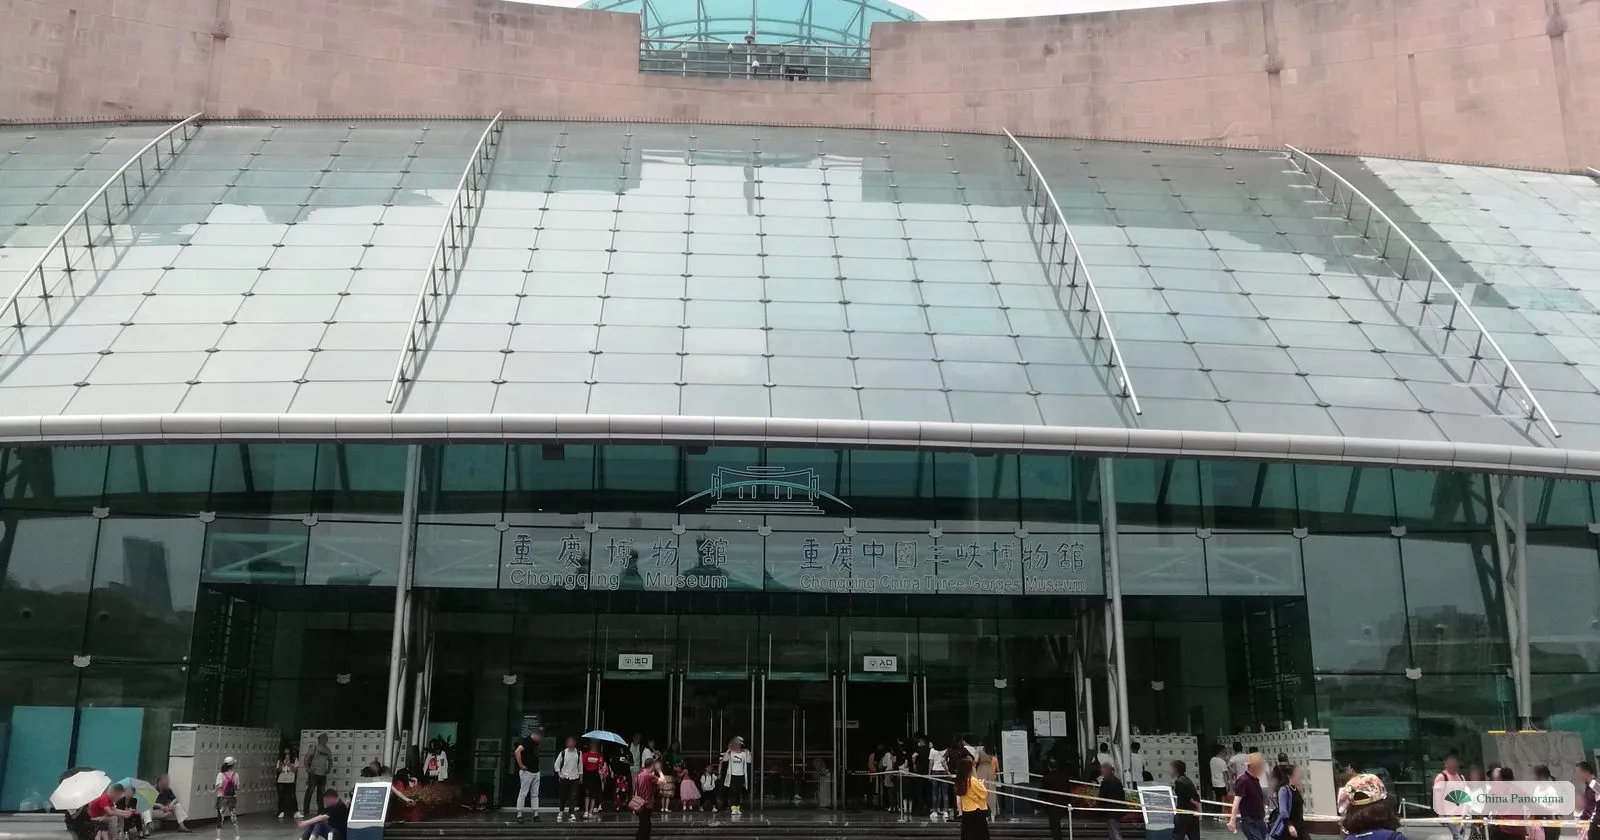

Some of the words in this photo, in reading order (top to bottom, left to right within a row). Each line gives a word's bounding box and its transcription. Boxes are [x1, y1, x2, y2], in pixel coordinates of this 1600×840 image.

[510, 533, 728, 568] 重慶博物館
[509, 569, 620, 591] Chongqing
[645, 571, 729, 589] Museum
[799, 574, 876, 593] Chongqing
[878, 574, 921, 591] China
[922, 575, 967, 591] Three
[968, 576, 1022, 594] Gorges
[1023, 576, 1087, 593] Museum
